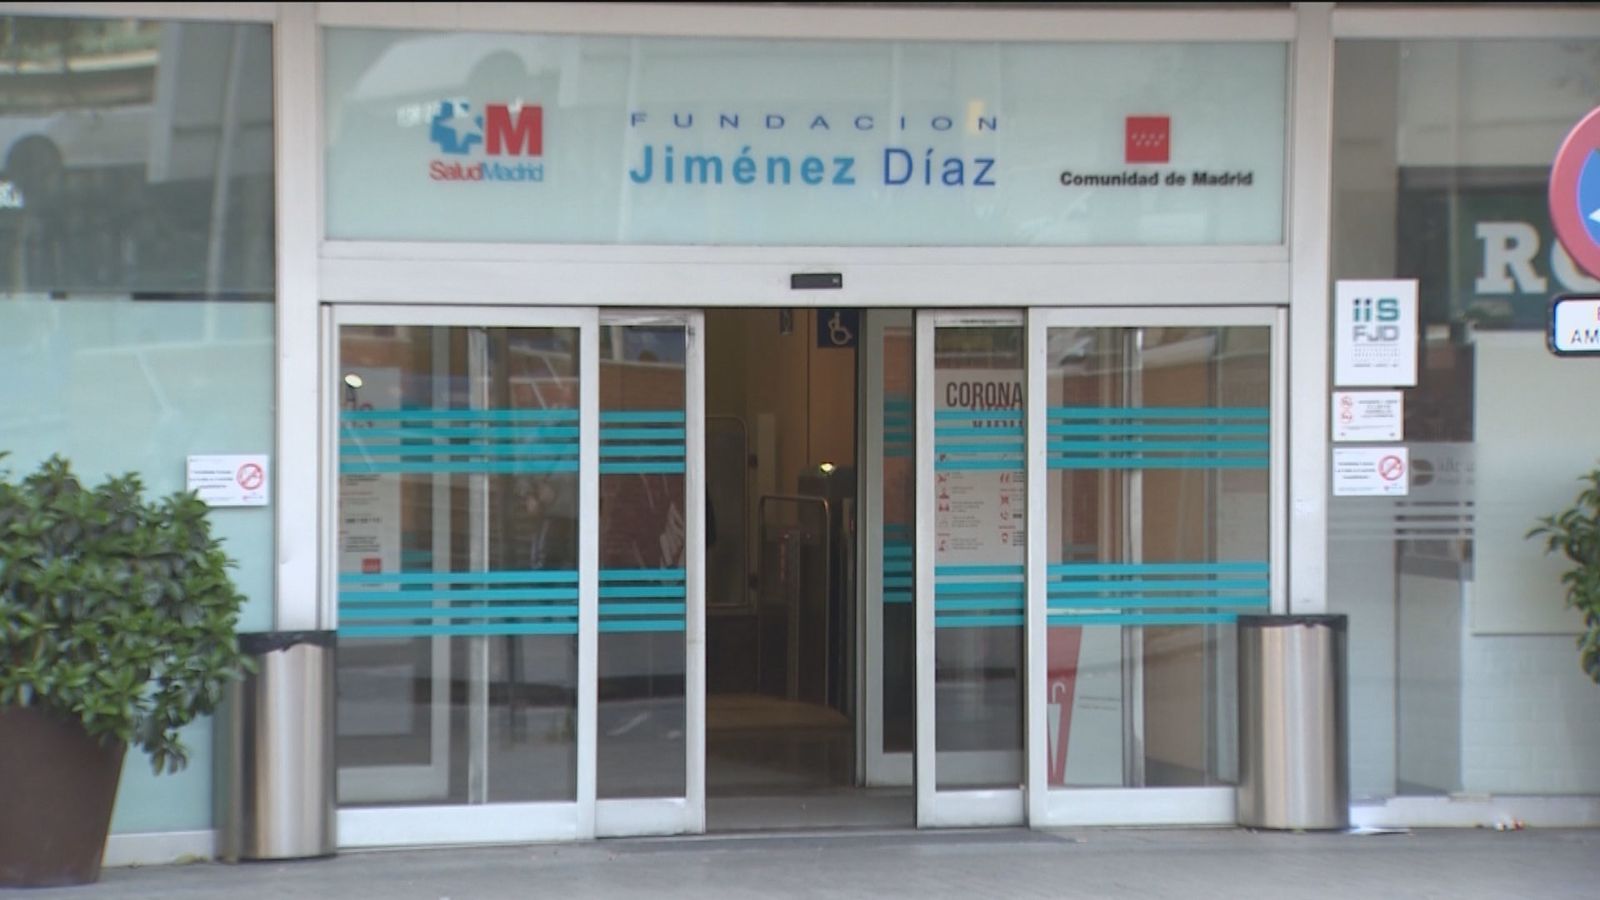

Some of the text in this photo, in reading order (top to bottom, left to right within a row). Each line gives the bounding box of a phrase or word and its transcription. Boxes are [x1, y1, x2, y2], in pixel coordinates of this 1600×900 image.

[486, 104, 543, 157] M
[630, 112, 998, 132] FUNDACION
[429, 160, 544, 182] SaludMadrid
[629, 145, 997, 187] Jiménez Díaz
[1060, 171, 1254, 187] Comunidad de Madrid
[1353, 325, 1400, 342] FJD
[946, 381, 1023, 408] CORONA
